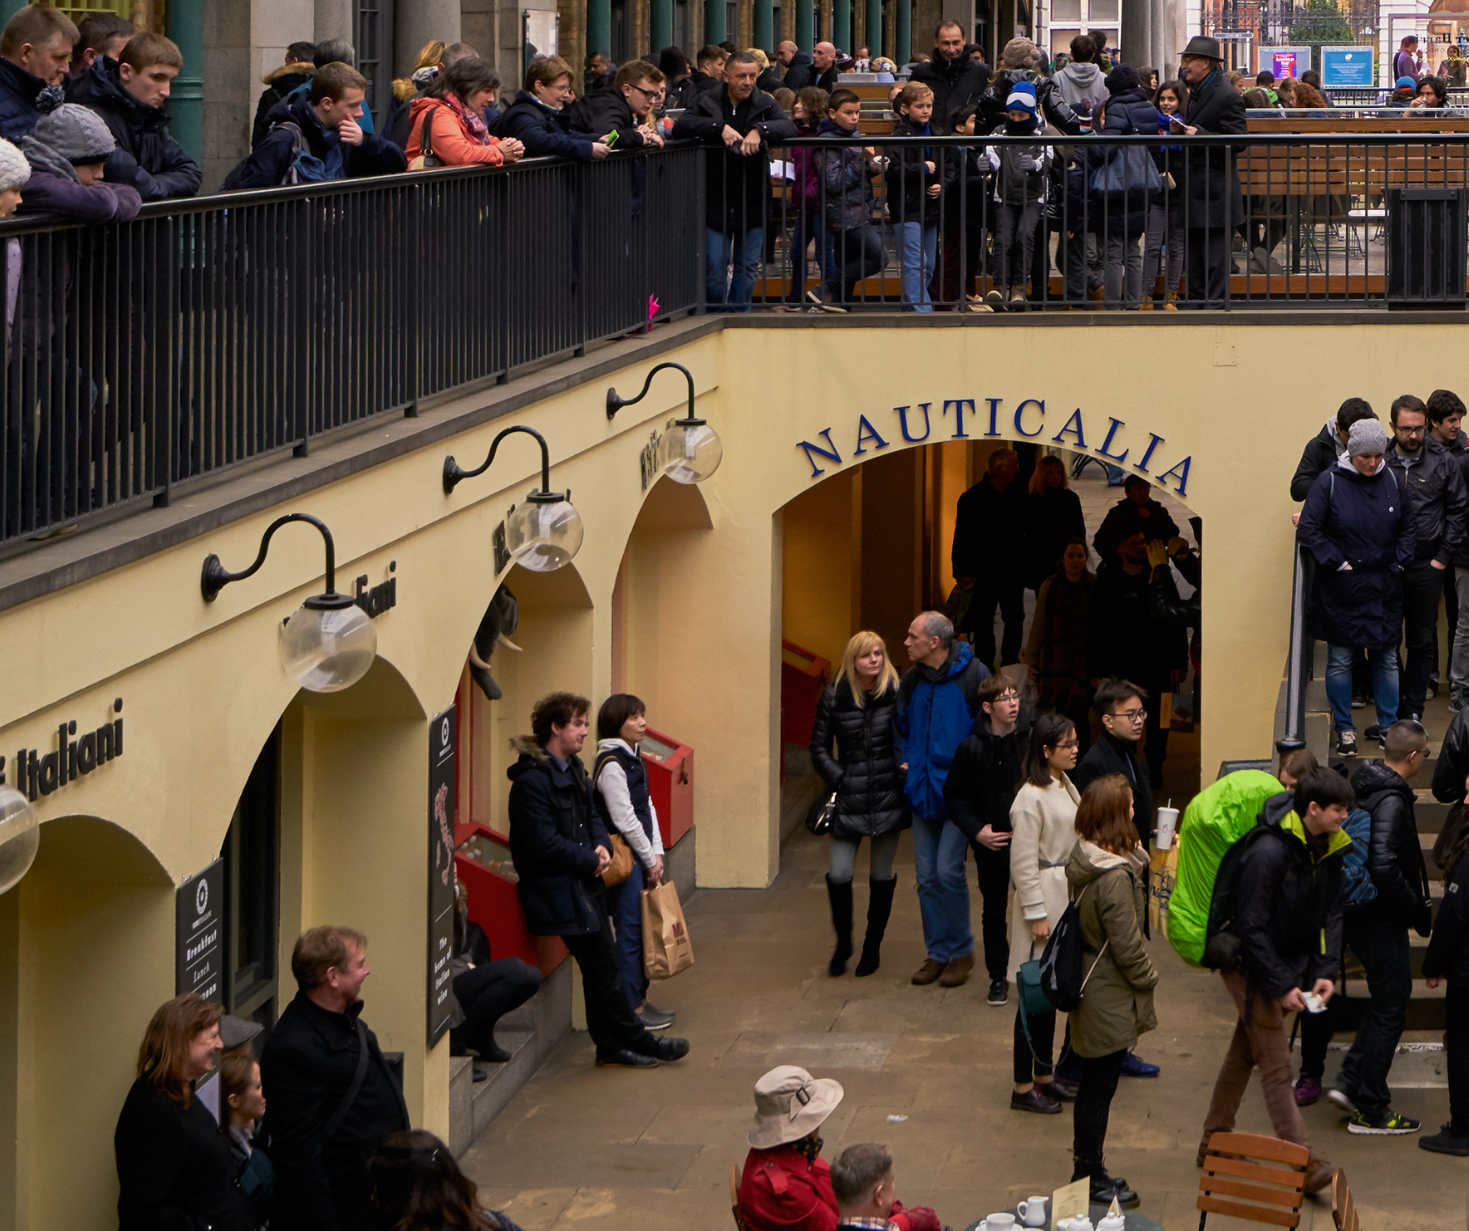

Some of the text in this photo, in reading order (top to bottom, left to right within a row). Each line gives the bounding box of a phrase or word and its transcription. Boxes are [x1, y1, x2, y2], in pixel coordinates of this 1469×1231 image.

[795, 398, 1193, 497] NAUTICALIA
[17, 697, 123, 803] Italiani
[186, 929, 217, 962] Breakfast
